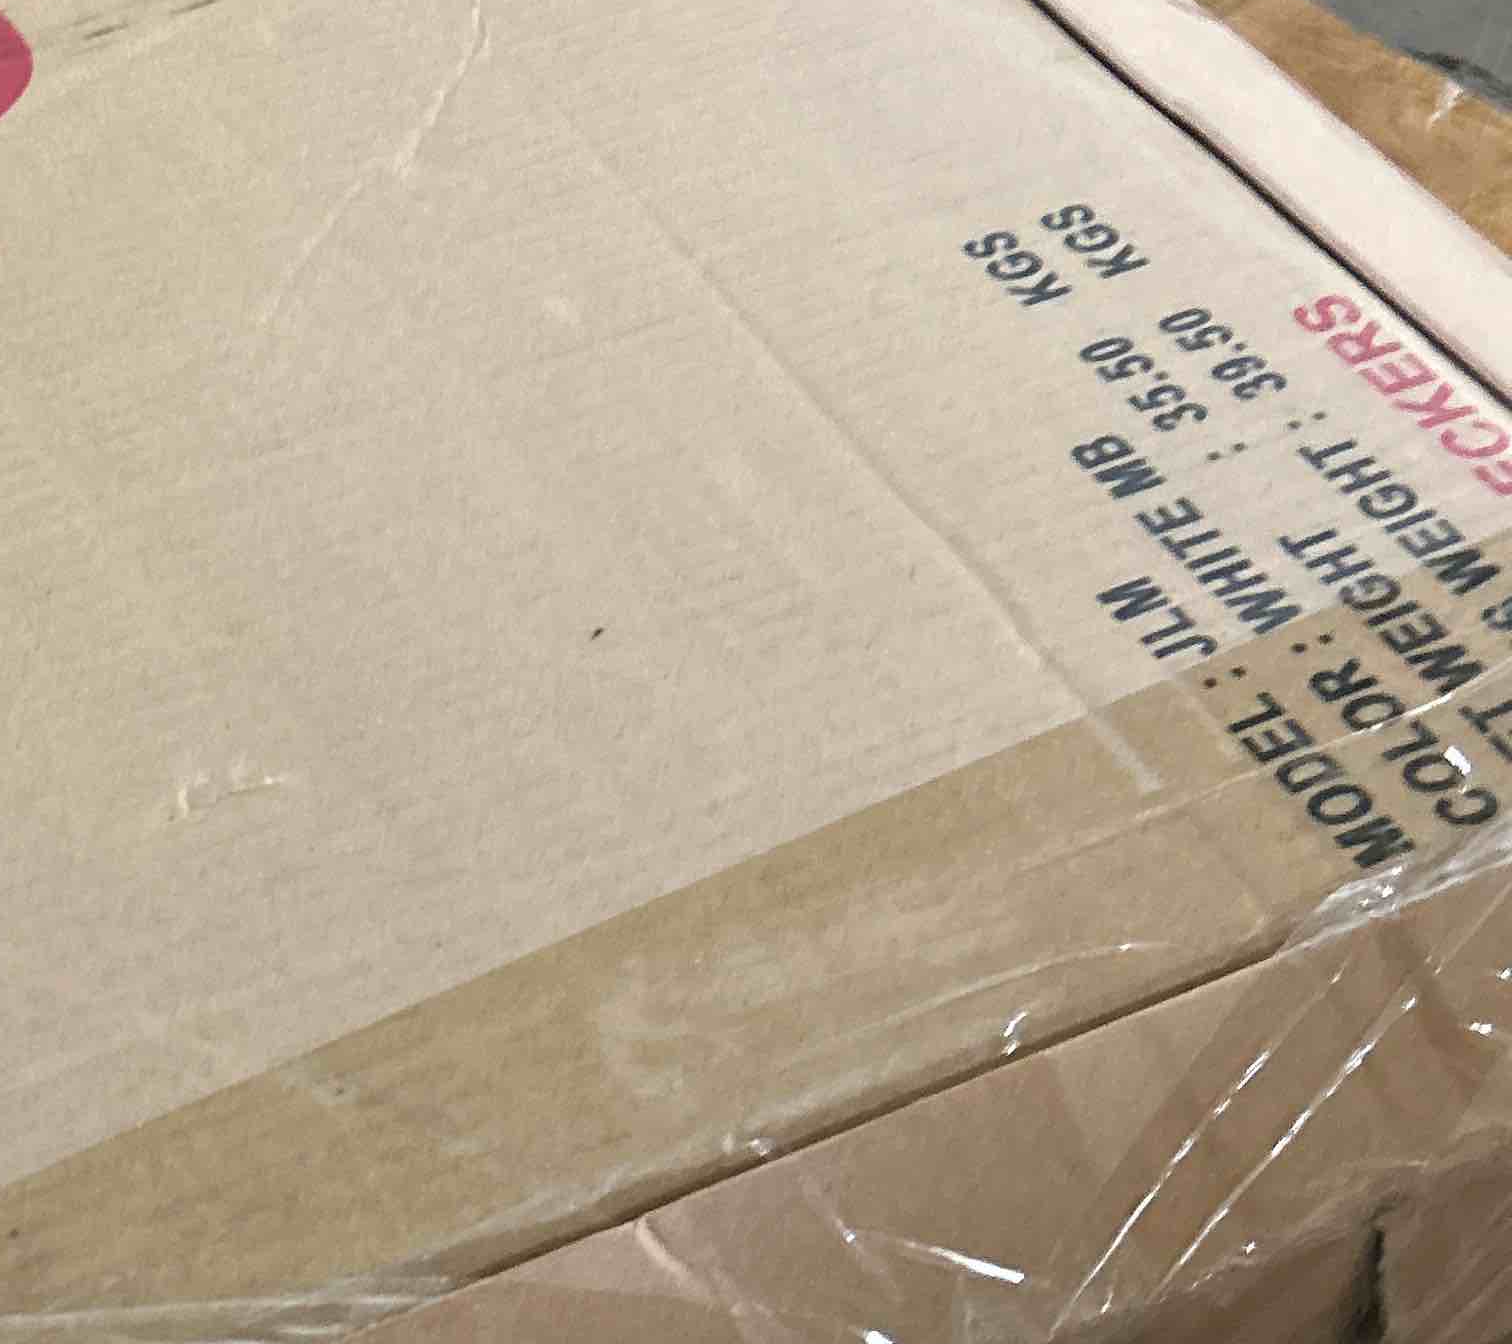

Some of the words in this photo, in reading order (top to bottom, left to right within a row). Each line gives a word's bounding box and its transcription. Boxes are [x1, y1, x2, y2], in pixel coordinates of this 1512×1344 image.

[961, 230, 1073, 307] KGS
[1041, 203, 1149, 280] KGS
[1078, 336, 1208, 432] 35.50
[1158, 308, 1287, 401] 39.50
[1070, 433, 1164, 501] MB
[1135, 496, 1302, 634] WHITE
[1297, 439, 1501, 595] WEIGHT
[1096, 576, 1219, 660] JLM
[1278, 528, 1488, 697] WEIGHT
[1226, 690, 1416, 869] MODEL
[1309, 657, 1499, 827] COLOR
